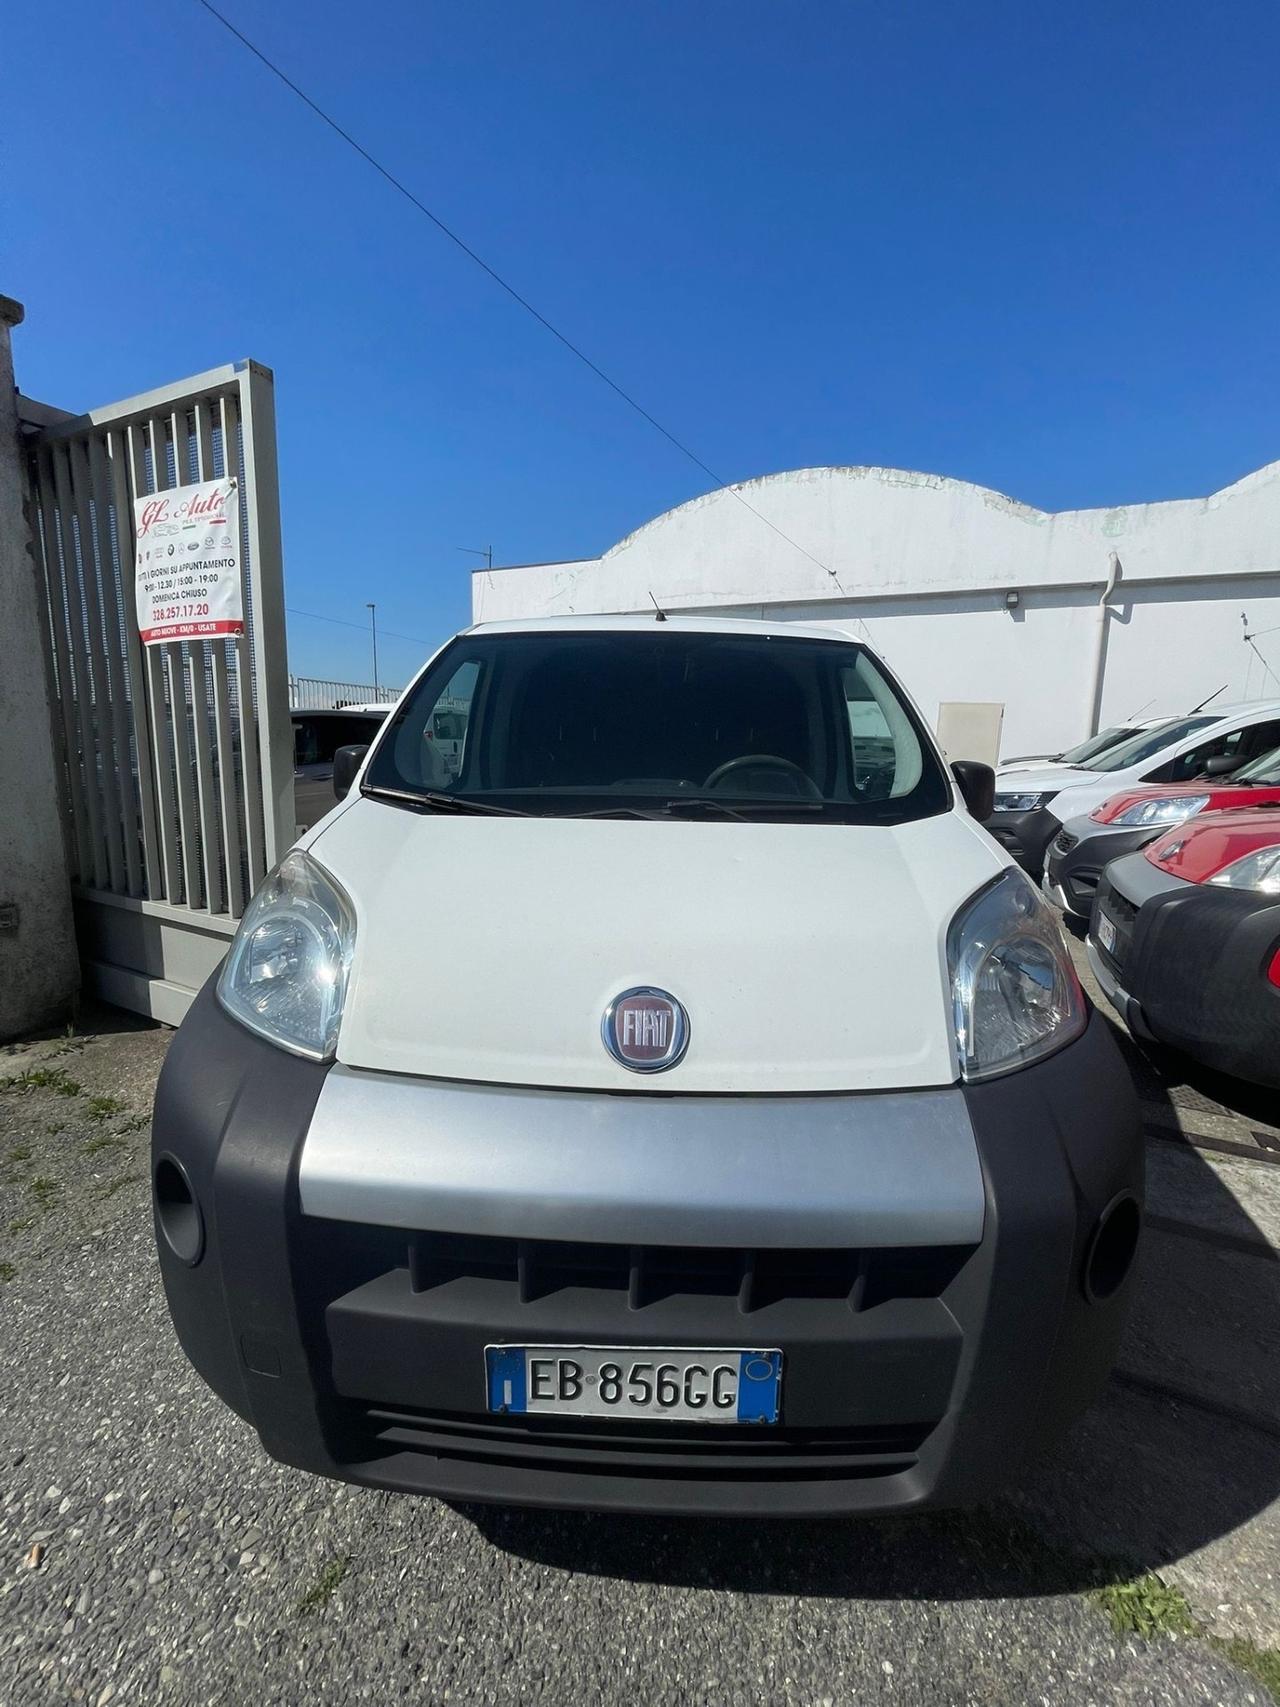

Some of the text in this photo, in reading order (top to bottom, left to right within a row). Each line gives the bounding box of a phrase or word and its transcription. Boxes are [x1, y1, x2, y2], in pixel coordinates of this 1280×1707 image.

[170, 565, 178, 574] SU
[179, 558, 236, 572] APPUNTAMENTO
[199, 573, 219, 583] 19:00
[152, 588, 208, 604] DOMENICA CHIUSO
[152, 603, 209, 621] 328.257.17.20
[197, 623, 217, 632] USATE
[623, 1009, 671, 1048] FIAT
[597, 1361, 737, 1409] 856GG
